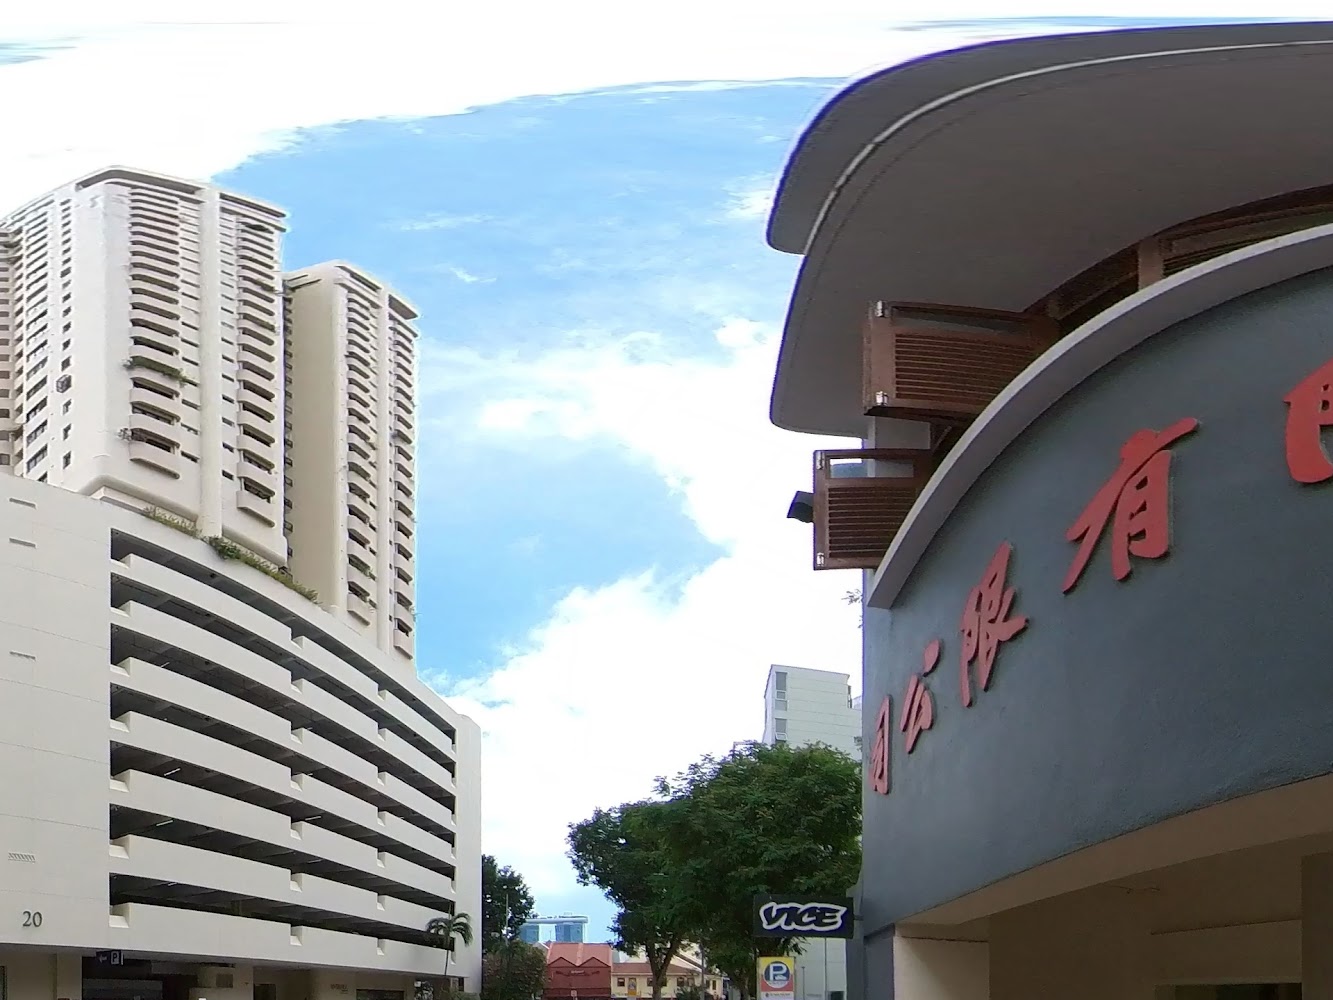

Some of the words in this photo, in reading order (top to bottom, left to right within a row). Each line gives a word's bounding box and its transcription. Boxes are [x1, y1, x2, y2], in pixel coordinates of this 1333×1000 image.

[22, 911, 43, 928] 20
[759, 901, 848, 932] VICE
[769, 963, 788, 981] P
